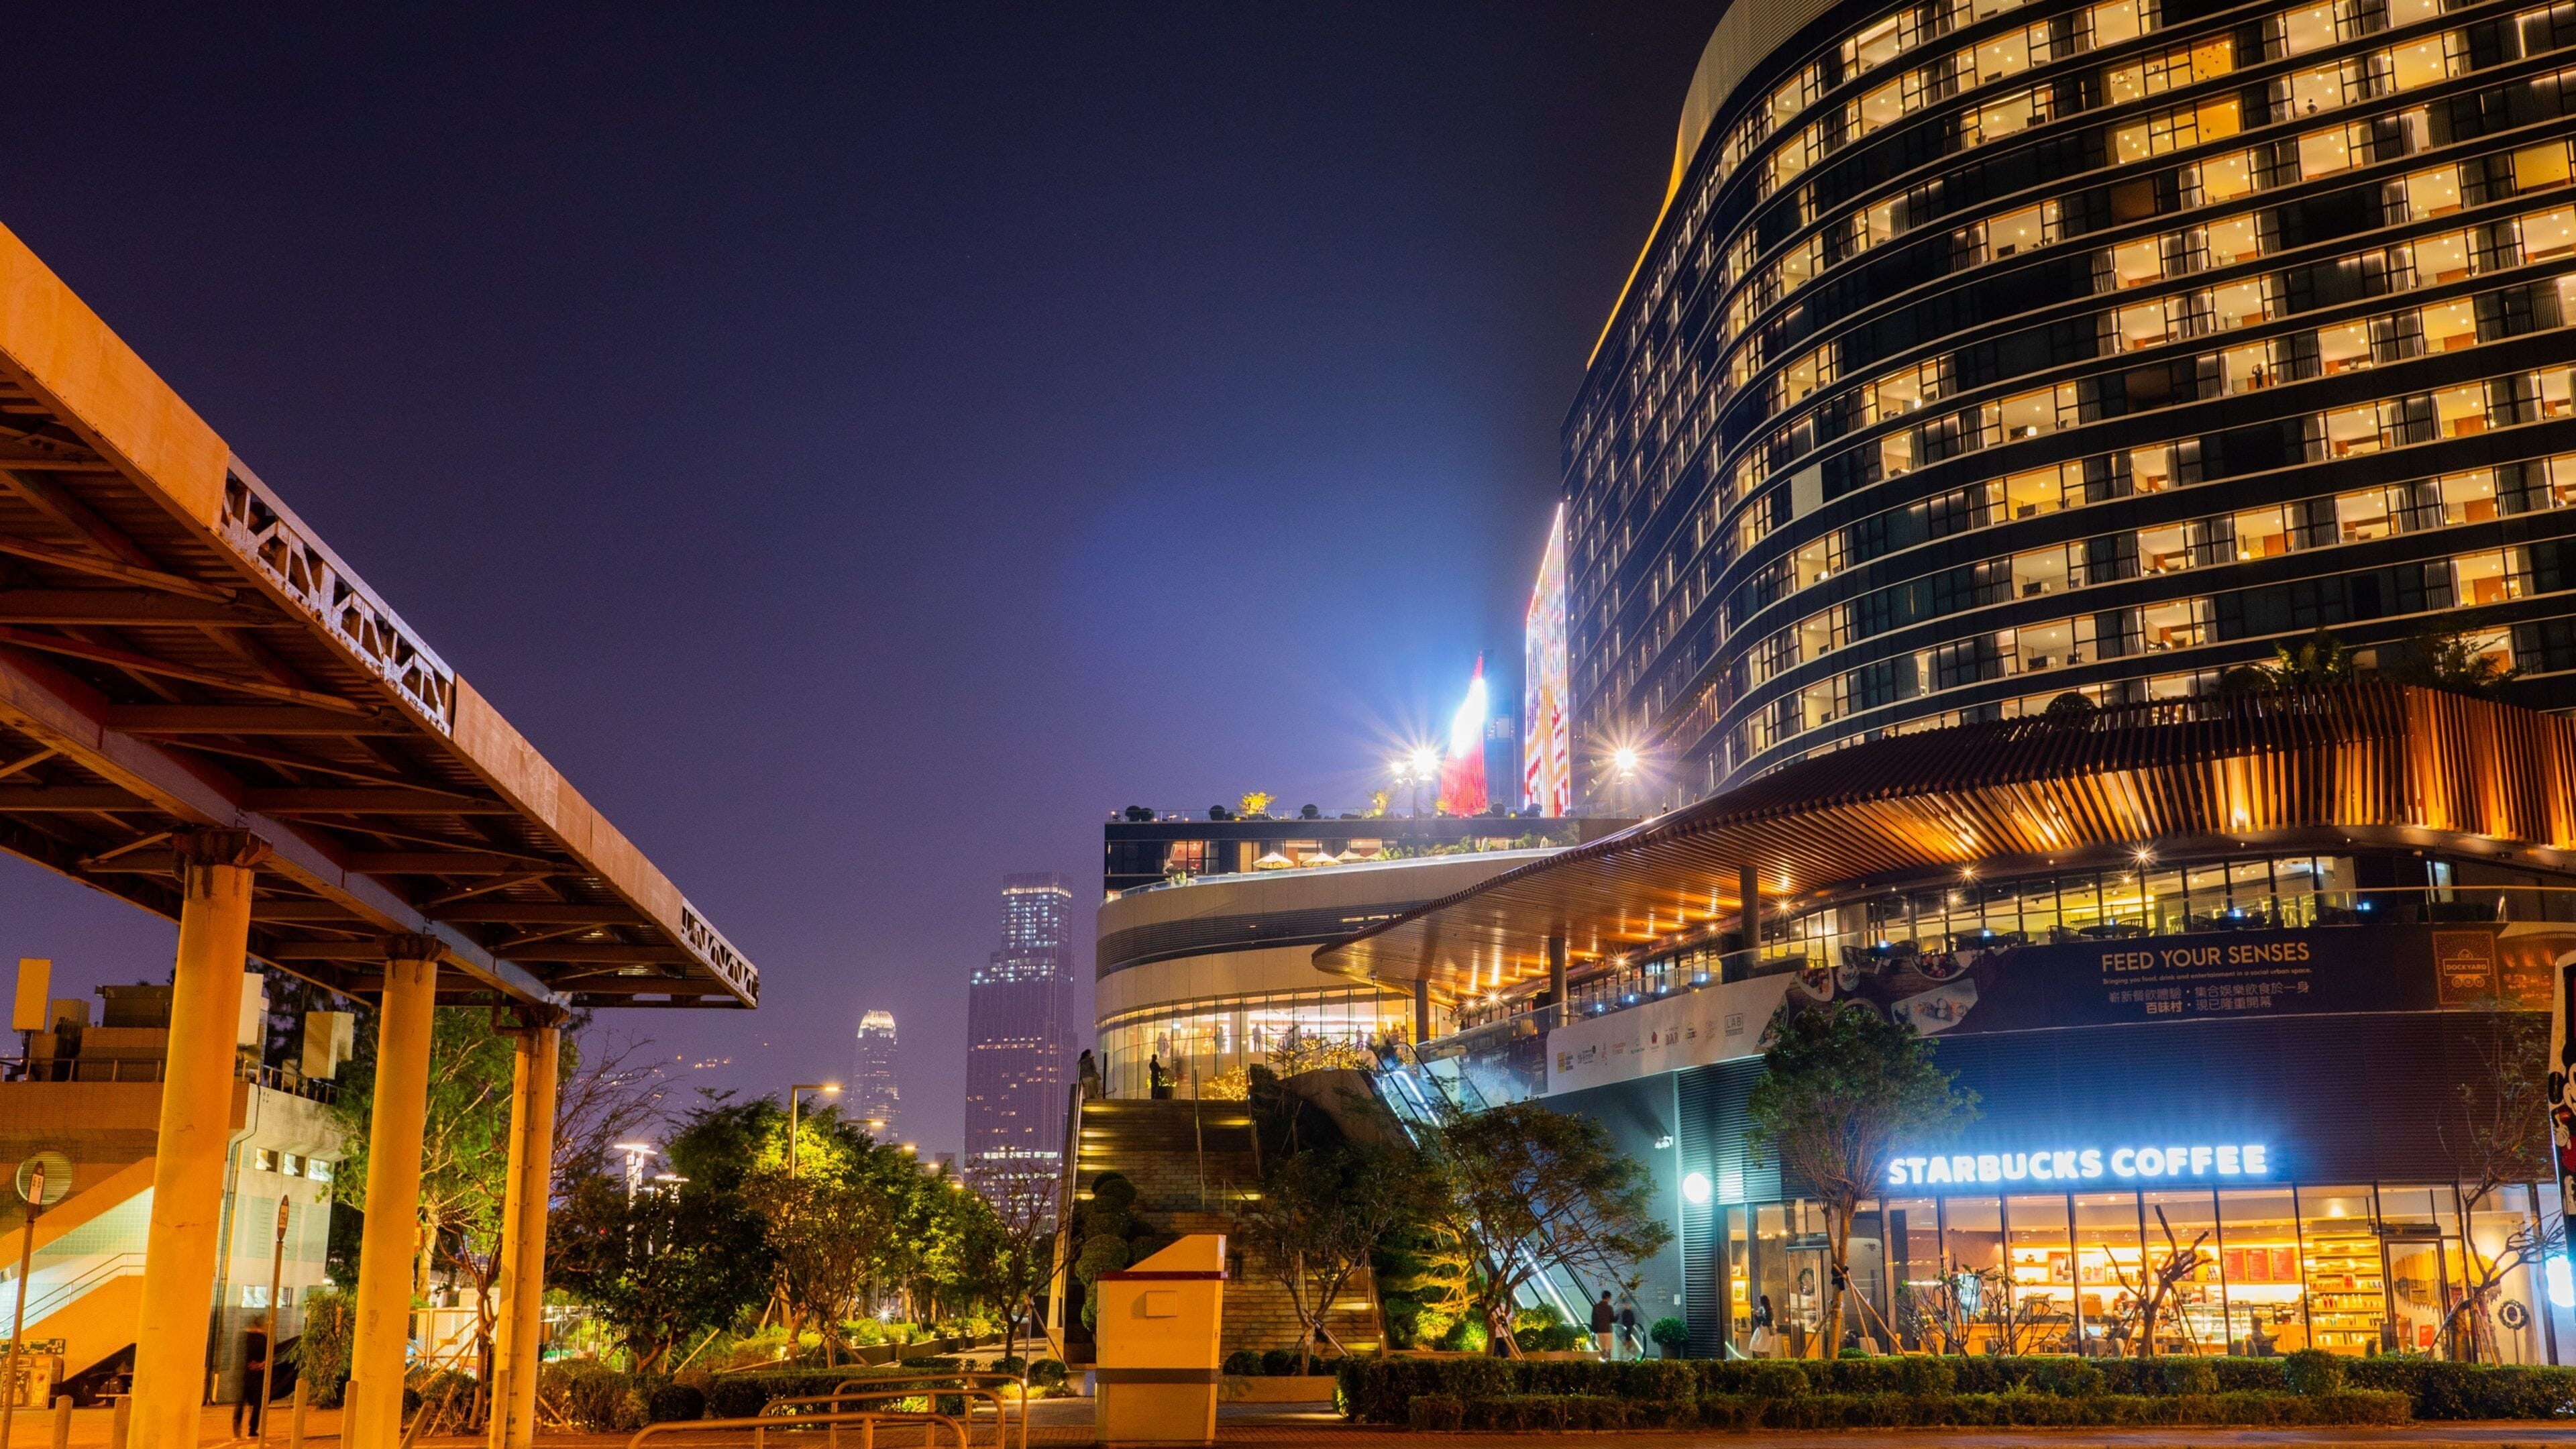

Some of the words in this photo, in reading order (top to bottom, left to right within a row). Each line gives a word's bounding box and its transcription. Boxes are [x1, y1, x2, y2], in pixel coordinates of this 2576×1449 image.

[2102, 951, 2154, 972] FEED
[2161, 947, 2222, 968] YOUR
[2228, 941, 2310, 964] SENSES
[2102, 977, 2129, 985] Bringing
[2190, 971, 2237, 979] entertainment
[2291, 967, 2312, 975] space.
[1726, 1016, 1741, 1028] LAB
[1665, 1032, 1679, 1046] BAR
[1888, 1149, 2104, 1185] STARBUCKS
[2111, 1145, 2267, 1177] COFFEE
